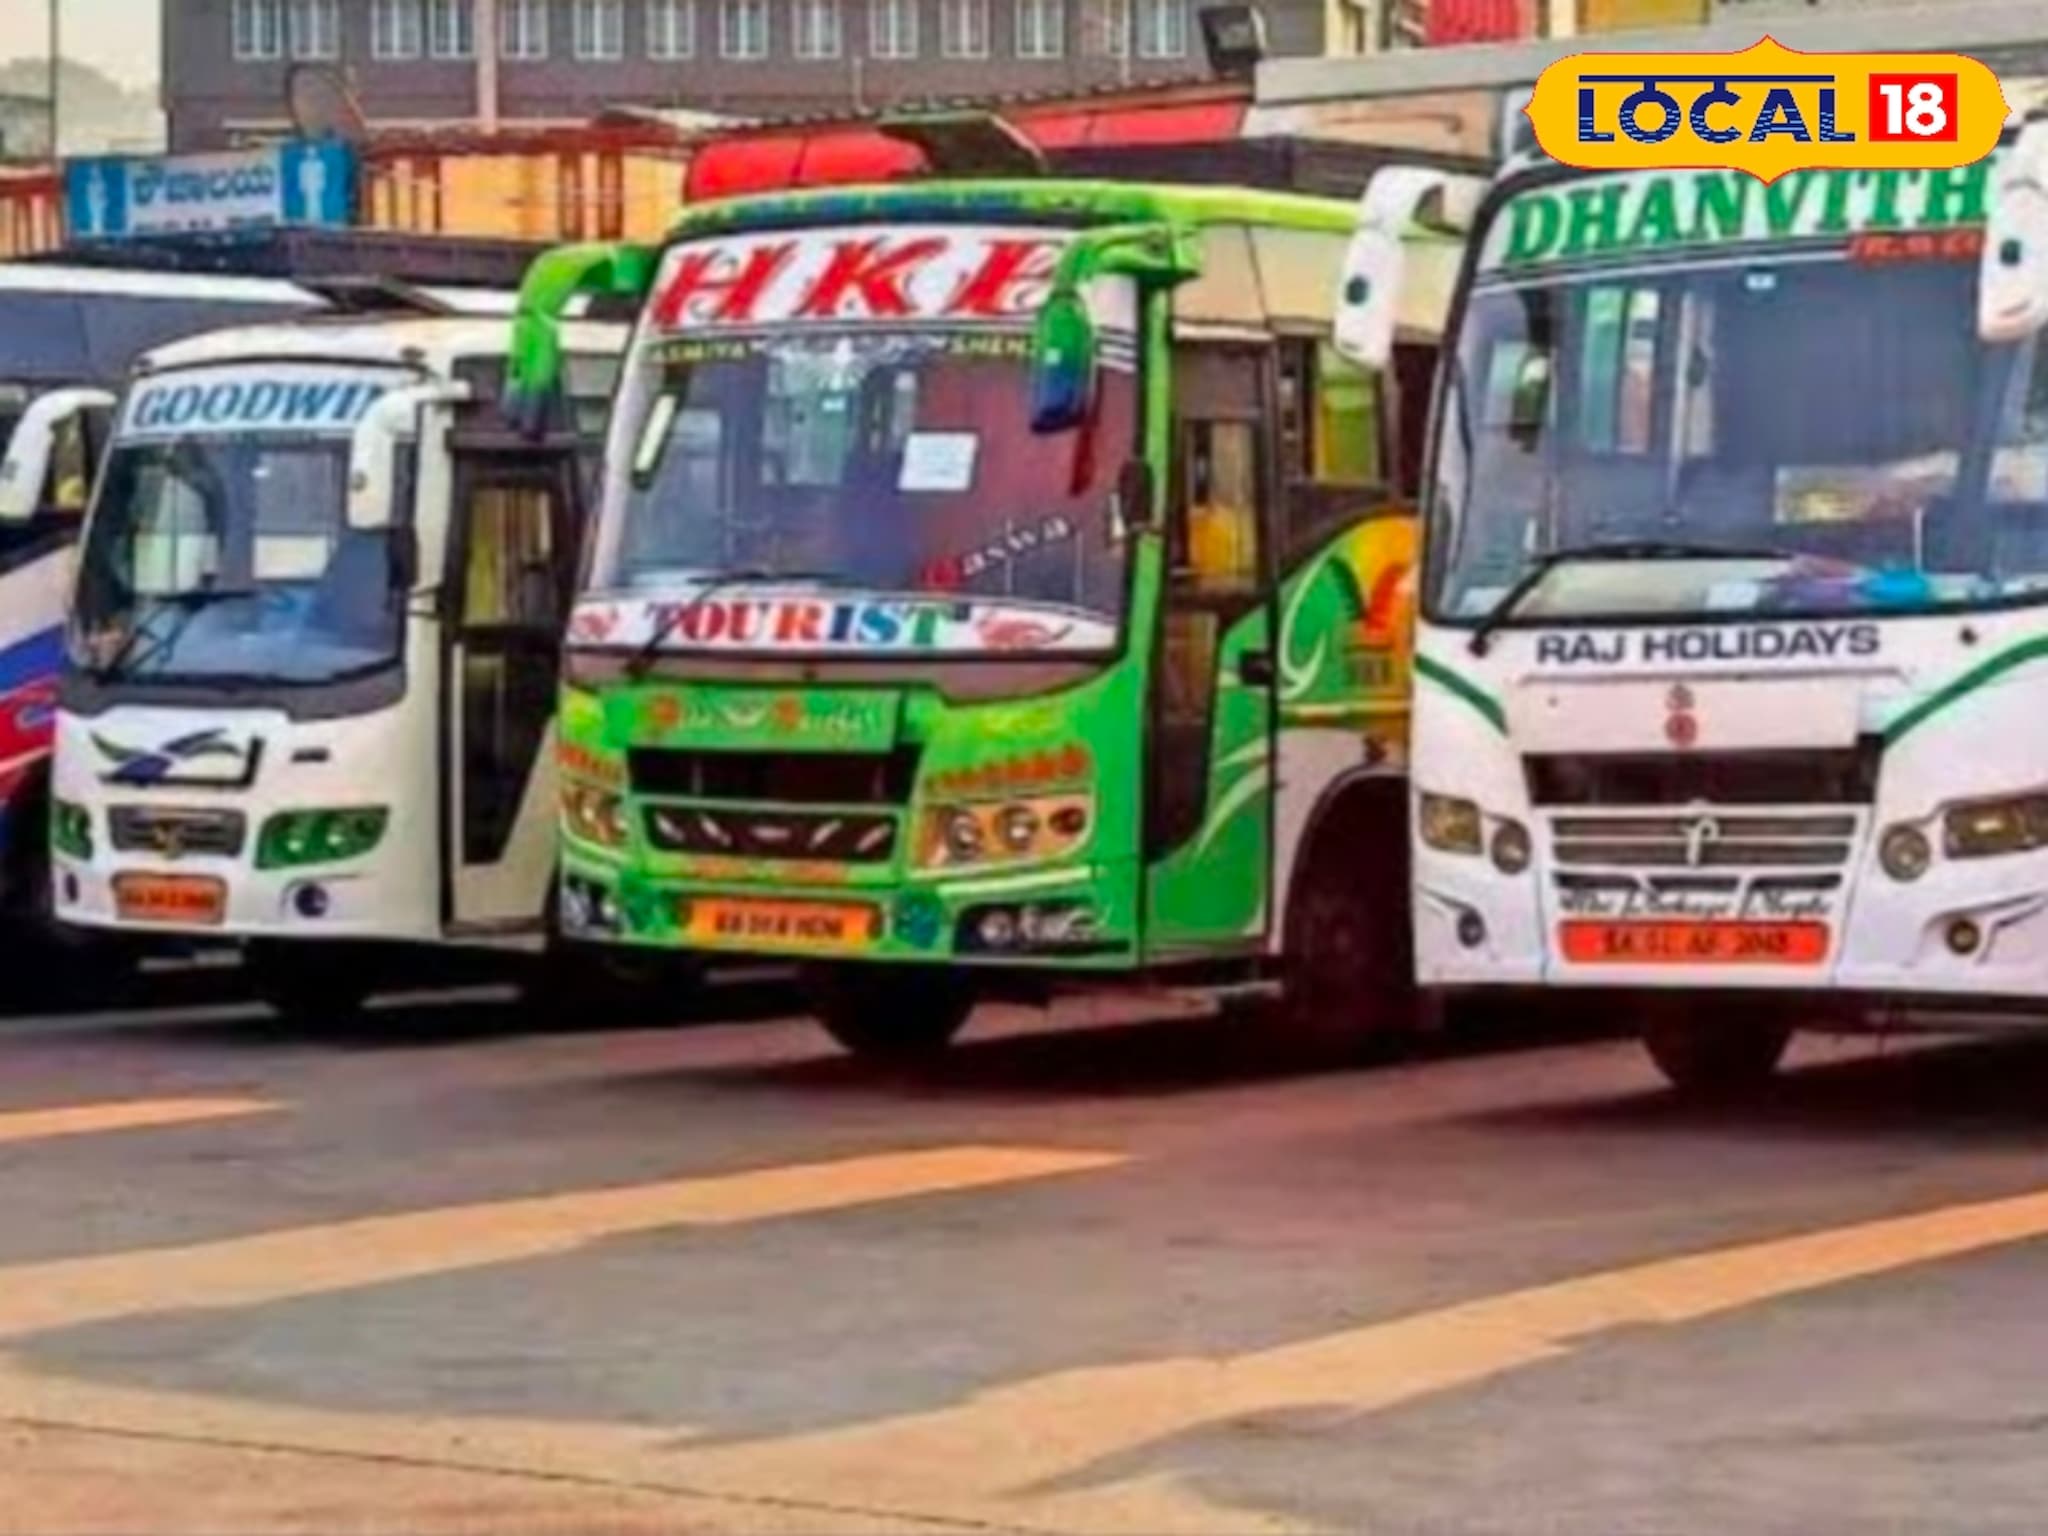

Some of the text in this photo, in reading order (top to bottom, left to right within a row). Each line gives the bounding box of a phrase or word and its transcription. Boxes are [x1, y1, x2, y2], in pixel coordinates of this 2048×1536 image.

[644, 602, 962, 645] TOURIST
[1536, 624, 1882, 665] RAJ HOLIDAYS
